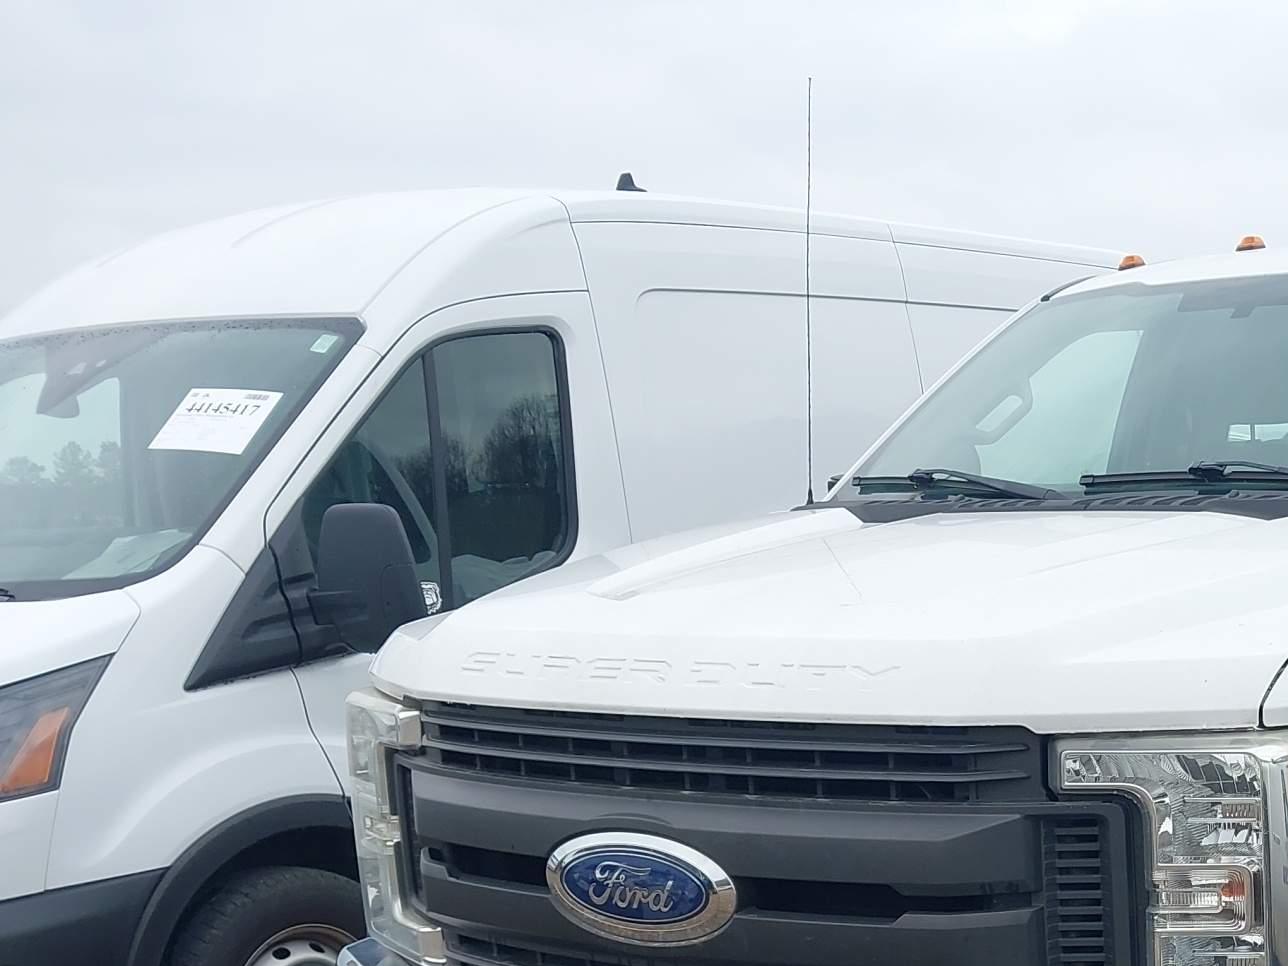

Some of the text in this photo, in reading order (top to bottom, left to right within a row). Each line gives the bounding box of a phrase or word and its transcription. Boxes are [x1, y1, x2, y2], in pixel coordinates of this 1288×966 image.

[185, 402, 262, 416] 44145417
[460, 651, 904, 693] SUPER DUTY
[588, 861, 675, 913] Ford
